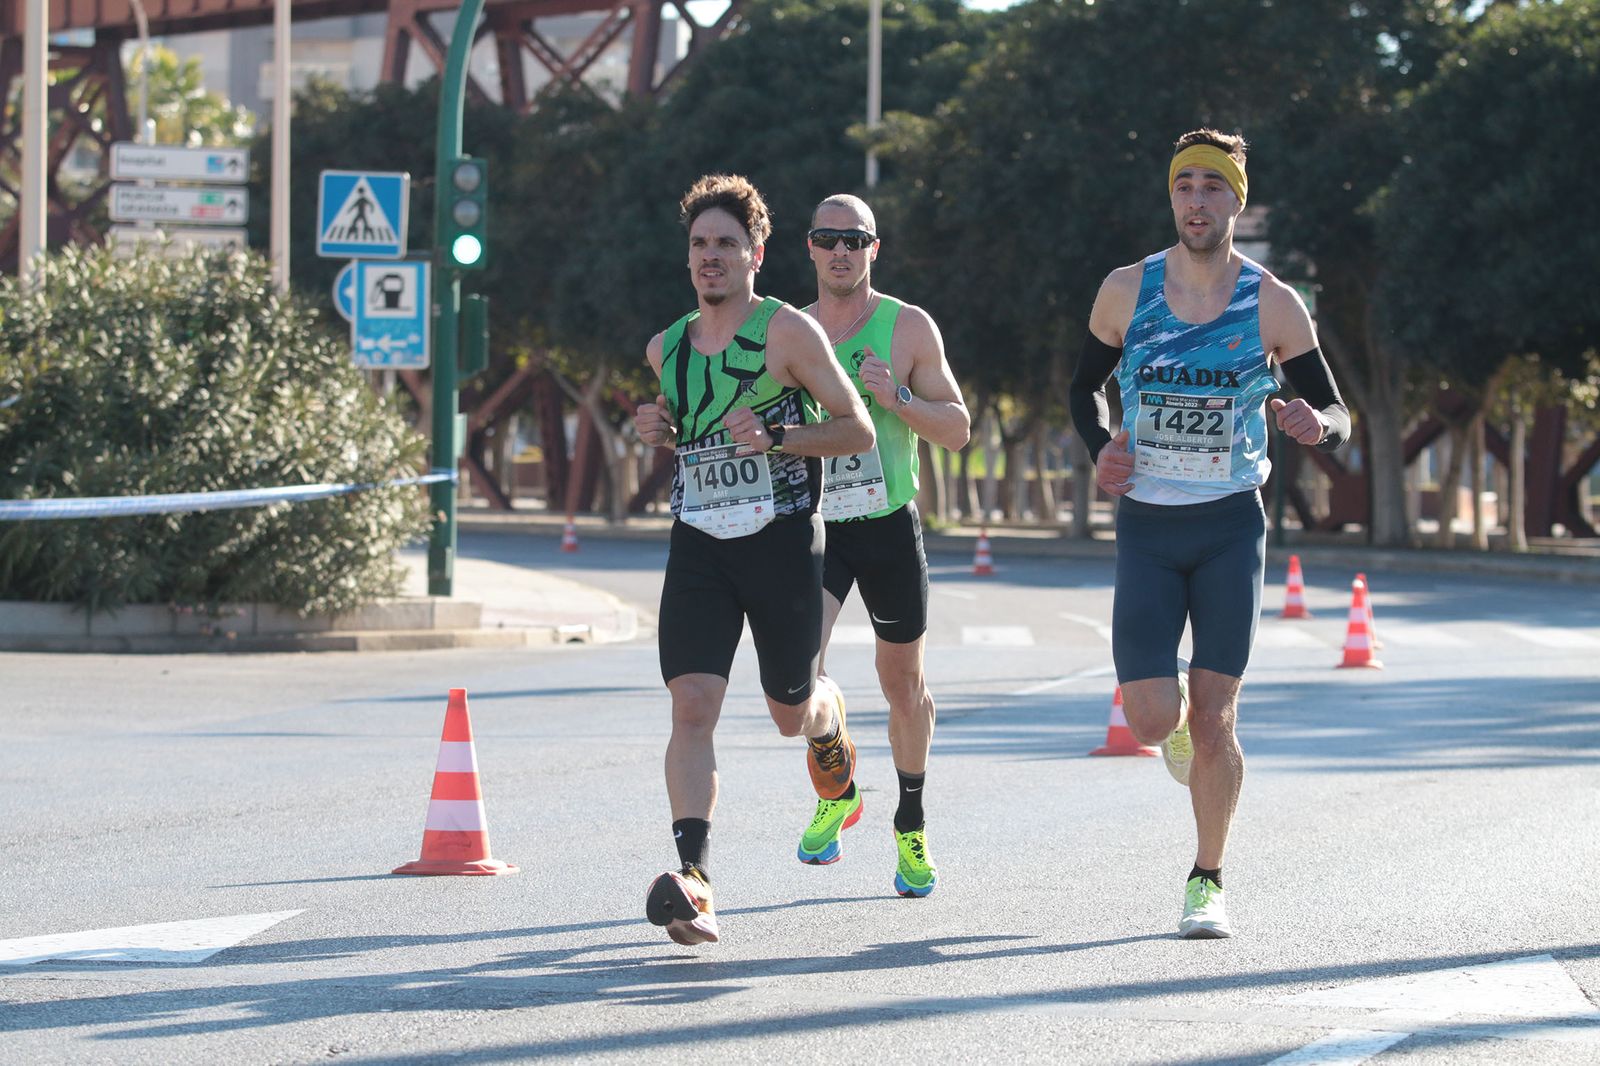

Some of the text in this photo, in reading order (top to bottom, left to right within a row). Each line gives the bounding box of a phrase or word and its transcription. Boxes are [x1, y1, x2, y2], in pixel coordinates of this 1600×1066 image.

[1139, 365, 1241, 388] GUADIX
[1149, 408, 1224, 436] 1422
[1155, 433, 1214, 444] JOSE ALBERTO
[693, 458, 759, 492] 1400
[835, 471, 864, 482] GARCIA
